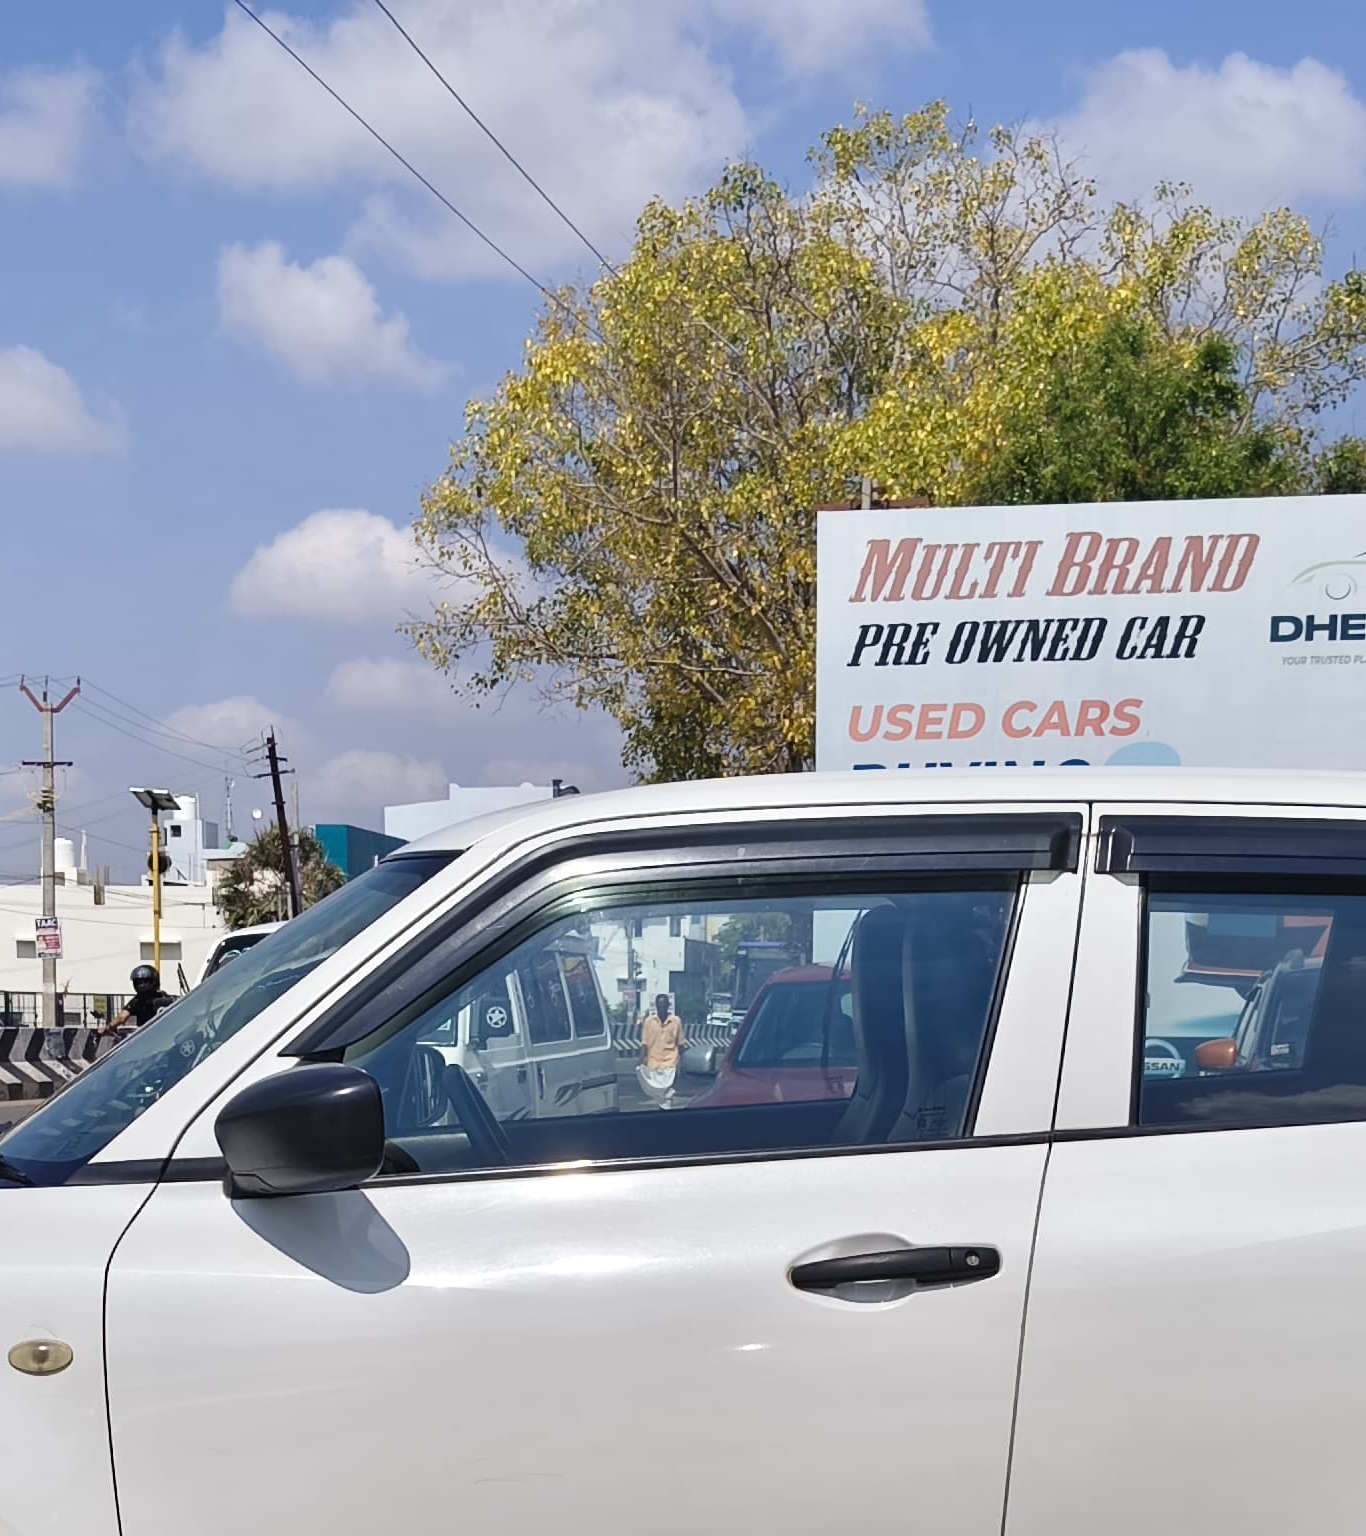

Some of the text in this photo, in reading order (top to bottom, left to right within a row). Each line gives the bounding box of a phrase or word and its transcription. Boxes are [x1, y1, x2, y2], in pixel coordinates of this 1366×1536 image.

[848, 531, 1260, 603] MULTI BRAND
[846, 614, 1206, 667] PRE OWNED CAR
[1282, 655, 1308, 666] YOUR
[1310, 655, 1352, 665] TRUSTED
[848, 698, 1143, 742] USED CARS
